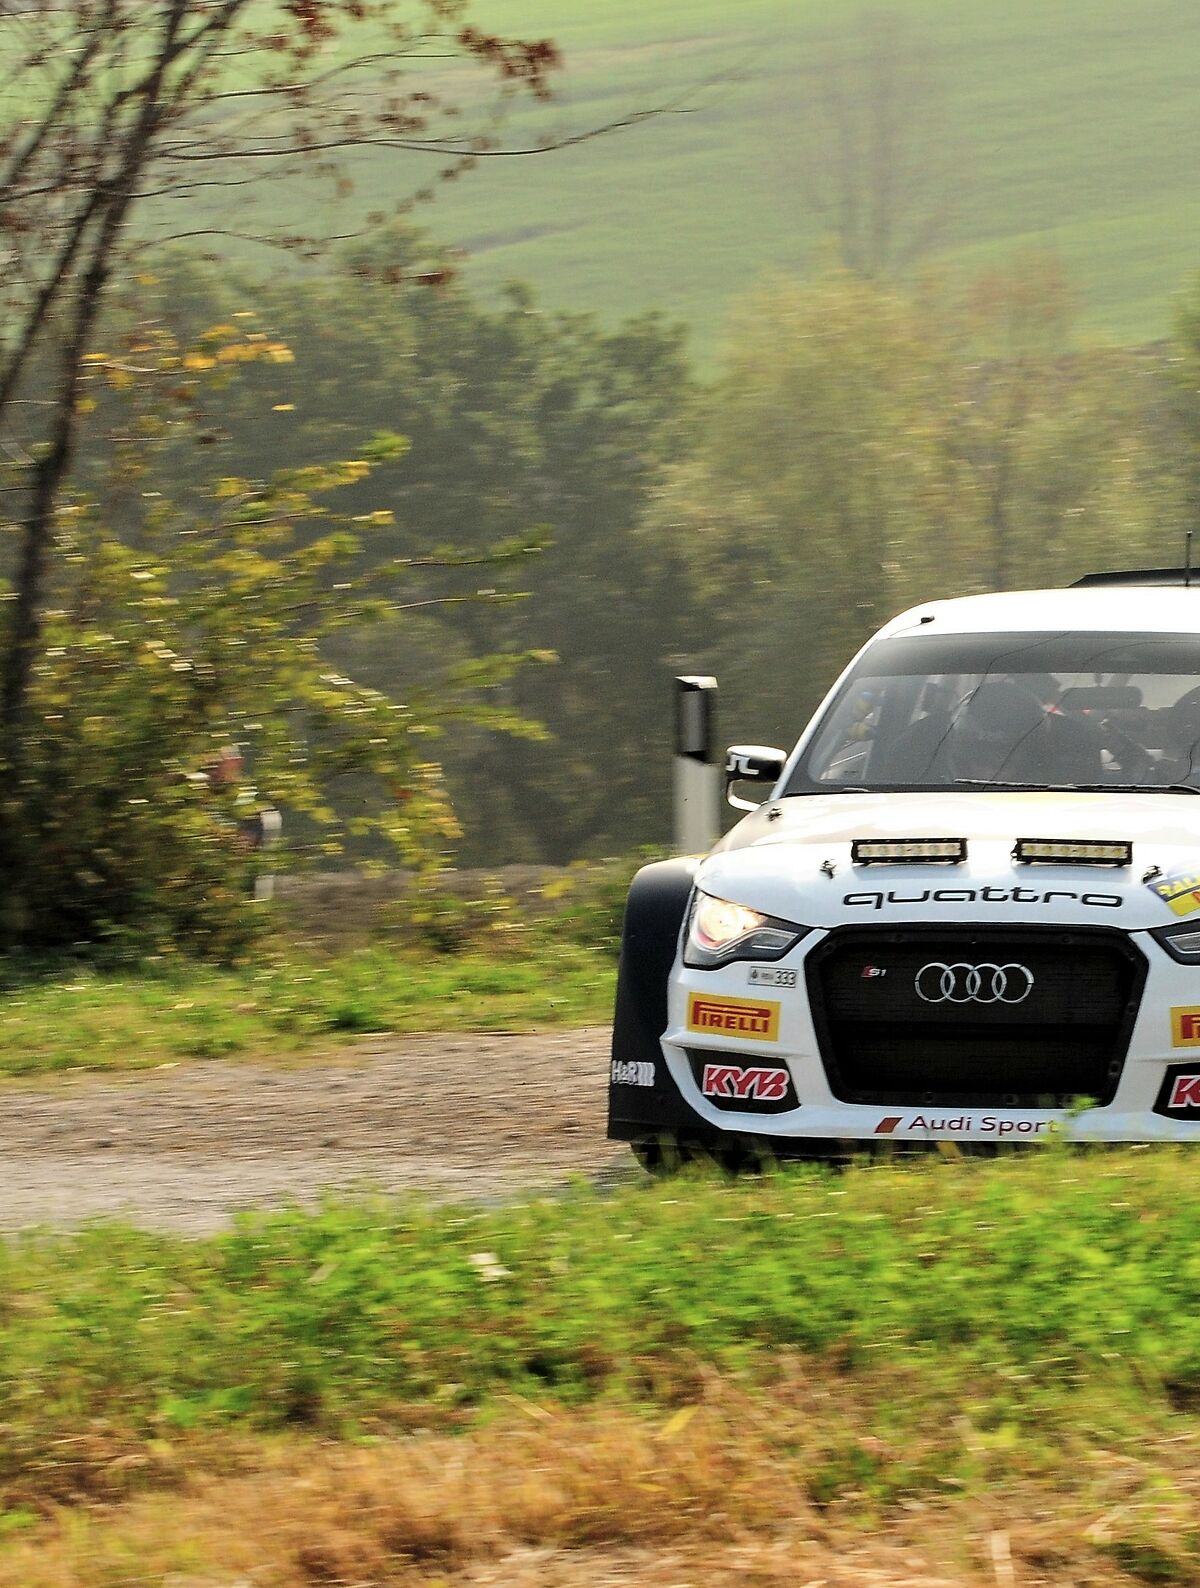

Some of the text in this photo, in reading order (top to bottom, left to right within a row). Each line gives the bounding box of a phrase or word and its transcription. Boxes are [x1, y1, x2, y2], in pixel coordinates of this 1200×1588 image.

[843, 886, 1123, 910] quattro
[775, 970, 796, 985] 333
[692, 1000, 771, 1033] PIRELLI
[703, 1064, 790, 1100] KYB
[908, 1116, 1060, 1136] Audi Sport
